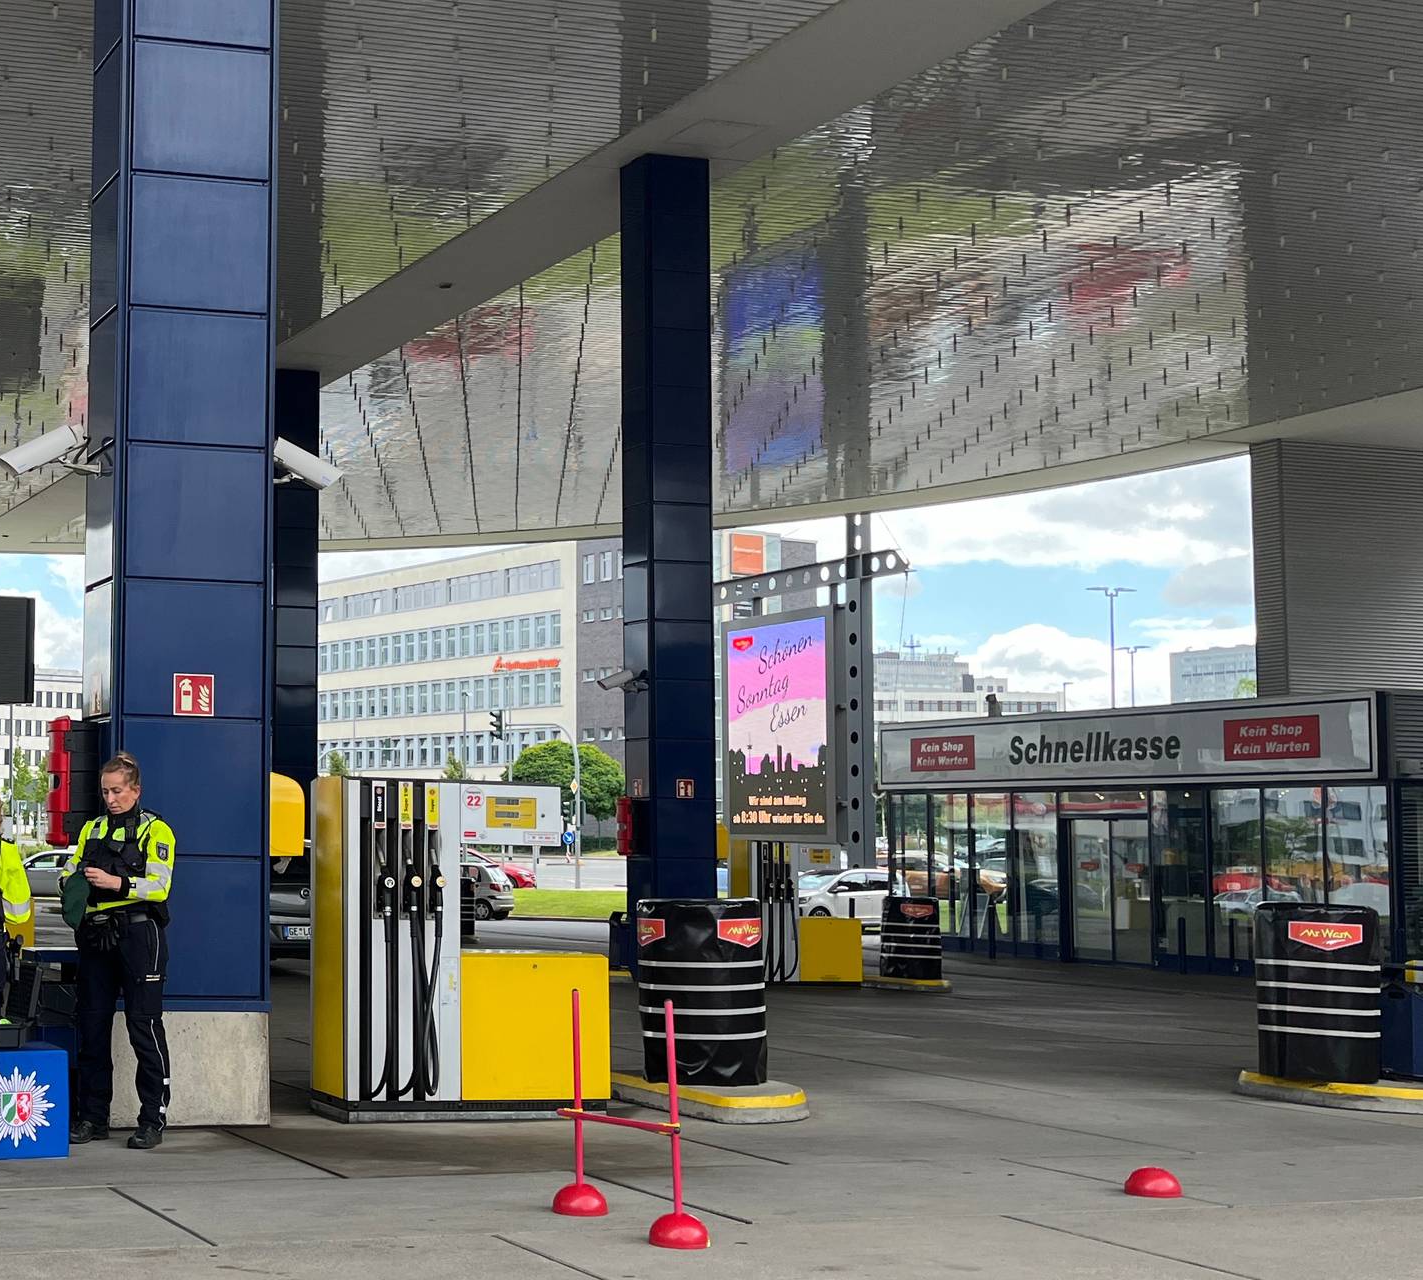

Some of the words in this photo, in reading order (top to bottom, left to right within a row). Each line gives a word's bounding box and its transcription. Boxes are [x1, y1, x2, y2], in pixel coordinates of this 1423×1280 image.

[758, 634, 814, 675] Schönen
[737, 675, 789, 714] Sonntag
[770, 702, 807, 733] Essen
[1240, 725, 1267, 738] Kein
[1271, 723, 1303, 737] Shop
[920, 742, 939, 753] Kein
[942, 741, 964, 753] Shop
[1009, 731, 1181, 765] Schnellkasse
[1233, 742, 1261, 755] Kein
[1265, 741, 1311, 754] Warten
[917, 756, 935, 767] Kein
[938, 755, 969, 766] Warten
[467, 796, 481, 806] 22
[758, 810, 772, 824] Uhr
[288, 927, 299, 936] GE
